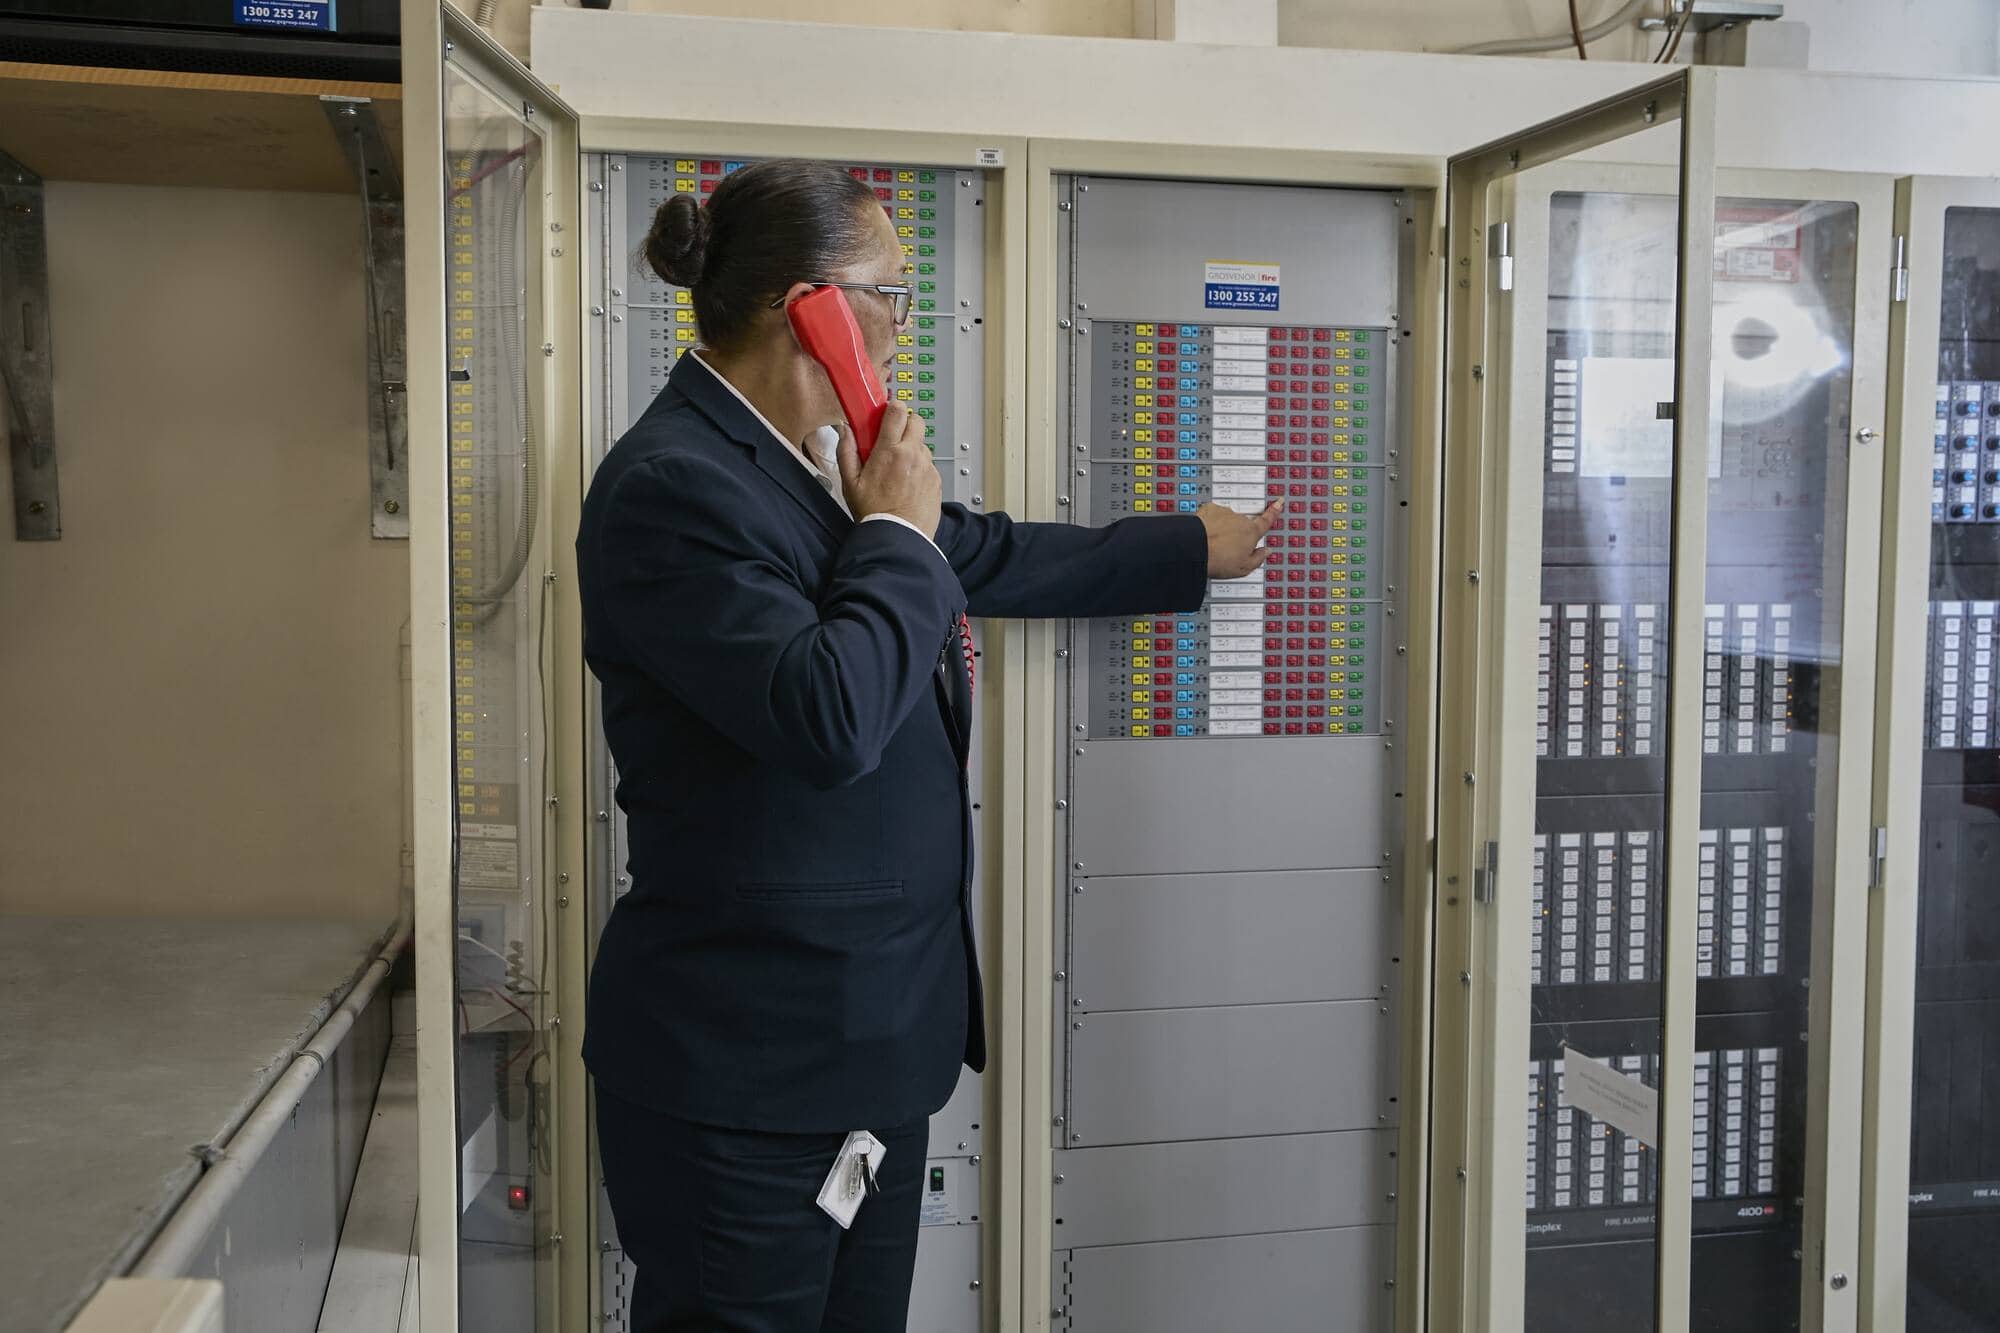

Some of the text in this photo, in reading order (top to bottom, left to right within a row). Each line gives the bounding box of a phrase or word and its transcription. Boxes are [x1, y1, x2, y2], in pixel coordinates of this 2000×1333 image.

[243, 6, 318, 20] 1300 255 247
[1261, 274, 1277, 282] fire
[1208, 290, 1278, 303] 1300 255 247
[1623, 1216, 1649, 1225] ALARM
